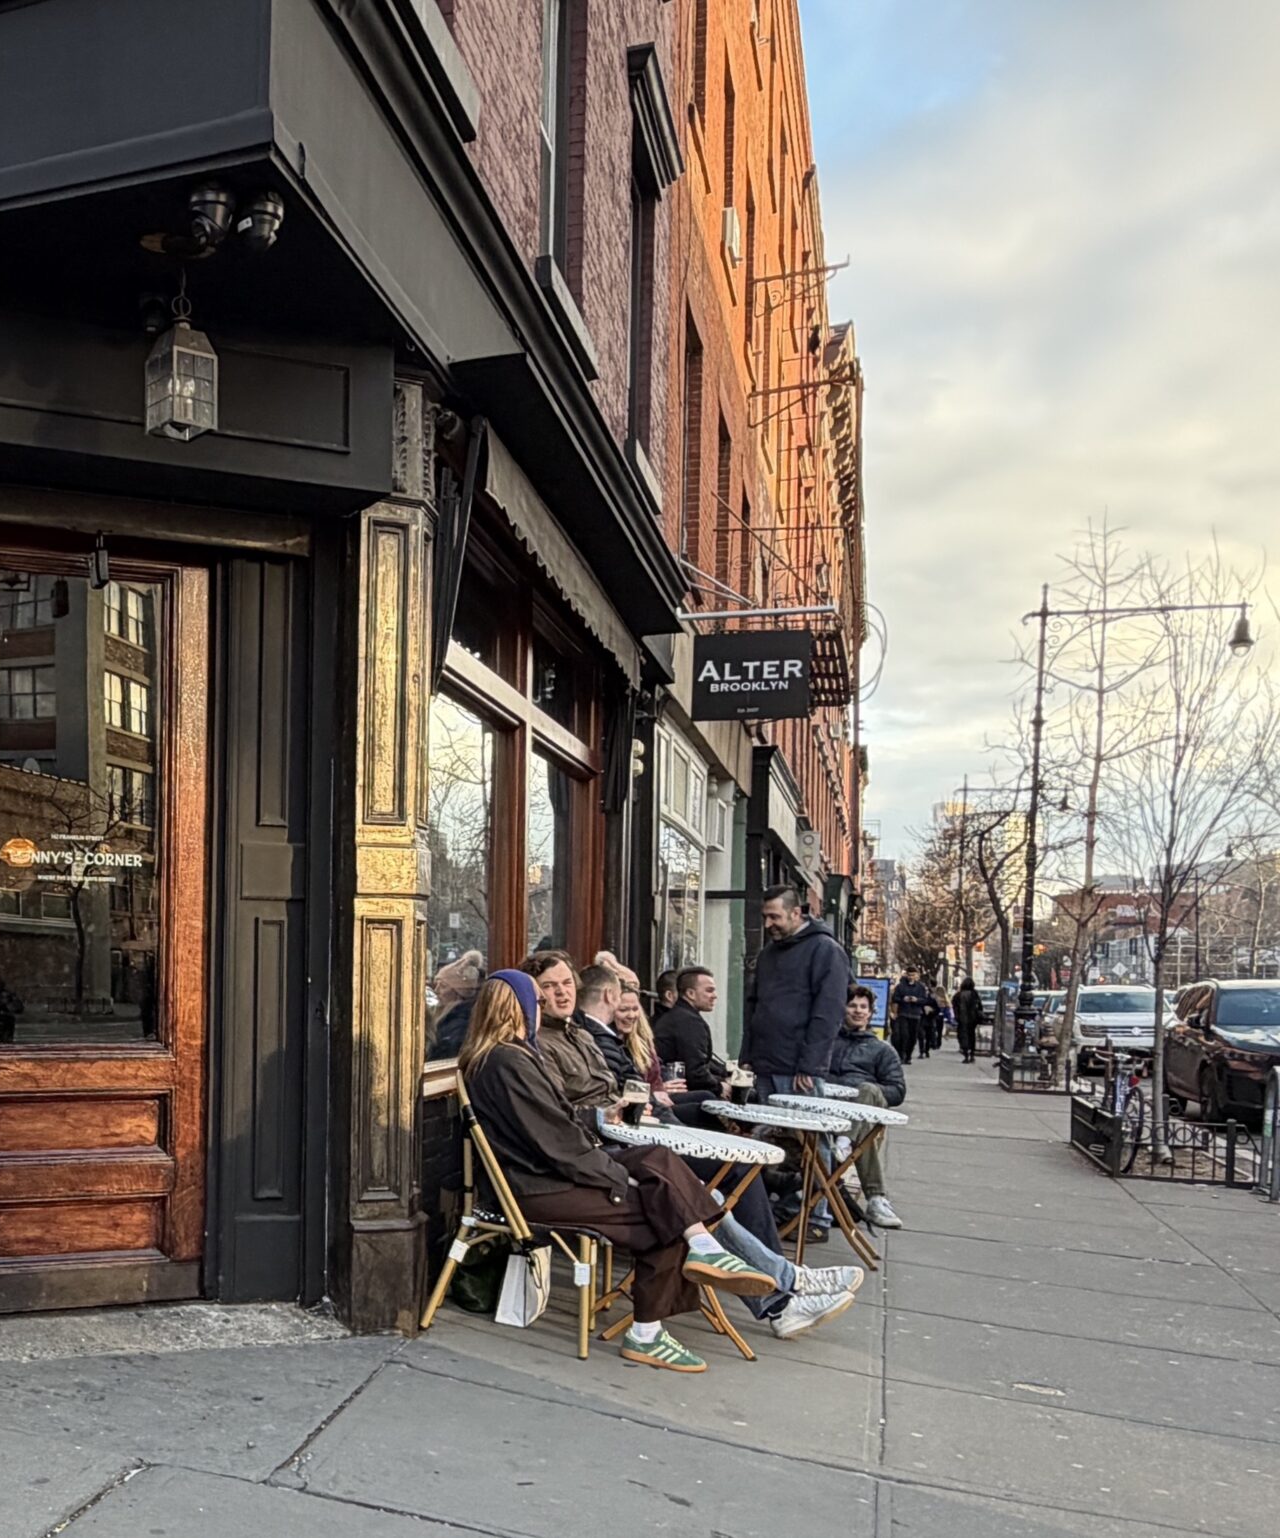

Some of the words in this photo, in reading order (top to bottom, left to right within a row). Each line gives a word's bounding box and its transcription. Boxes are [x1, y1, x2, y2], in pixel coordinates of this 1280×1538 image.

[698, 660, 803, 682] ALTER
[710, 681, 789, 692] BROOKLYN
[10, 850, 73, 864] NNY'S
[84, 852, 142, 867] CORNER
